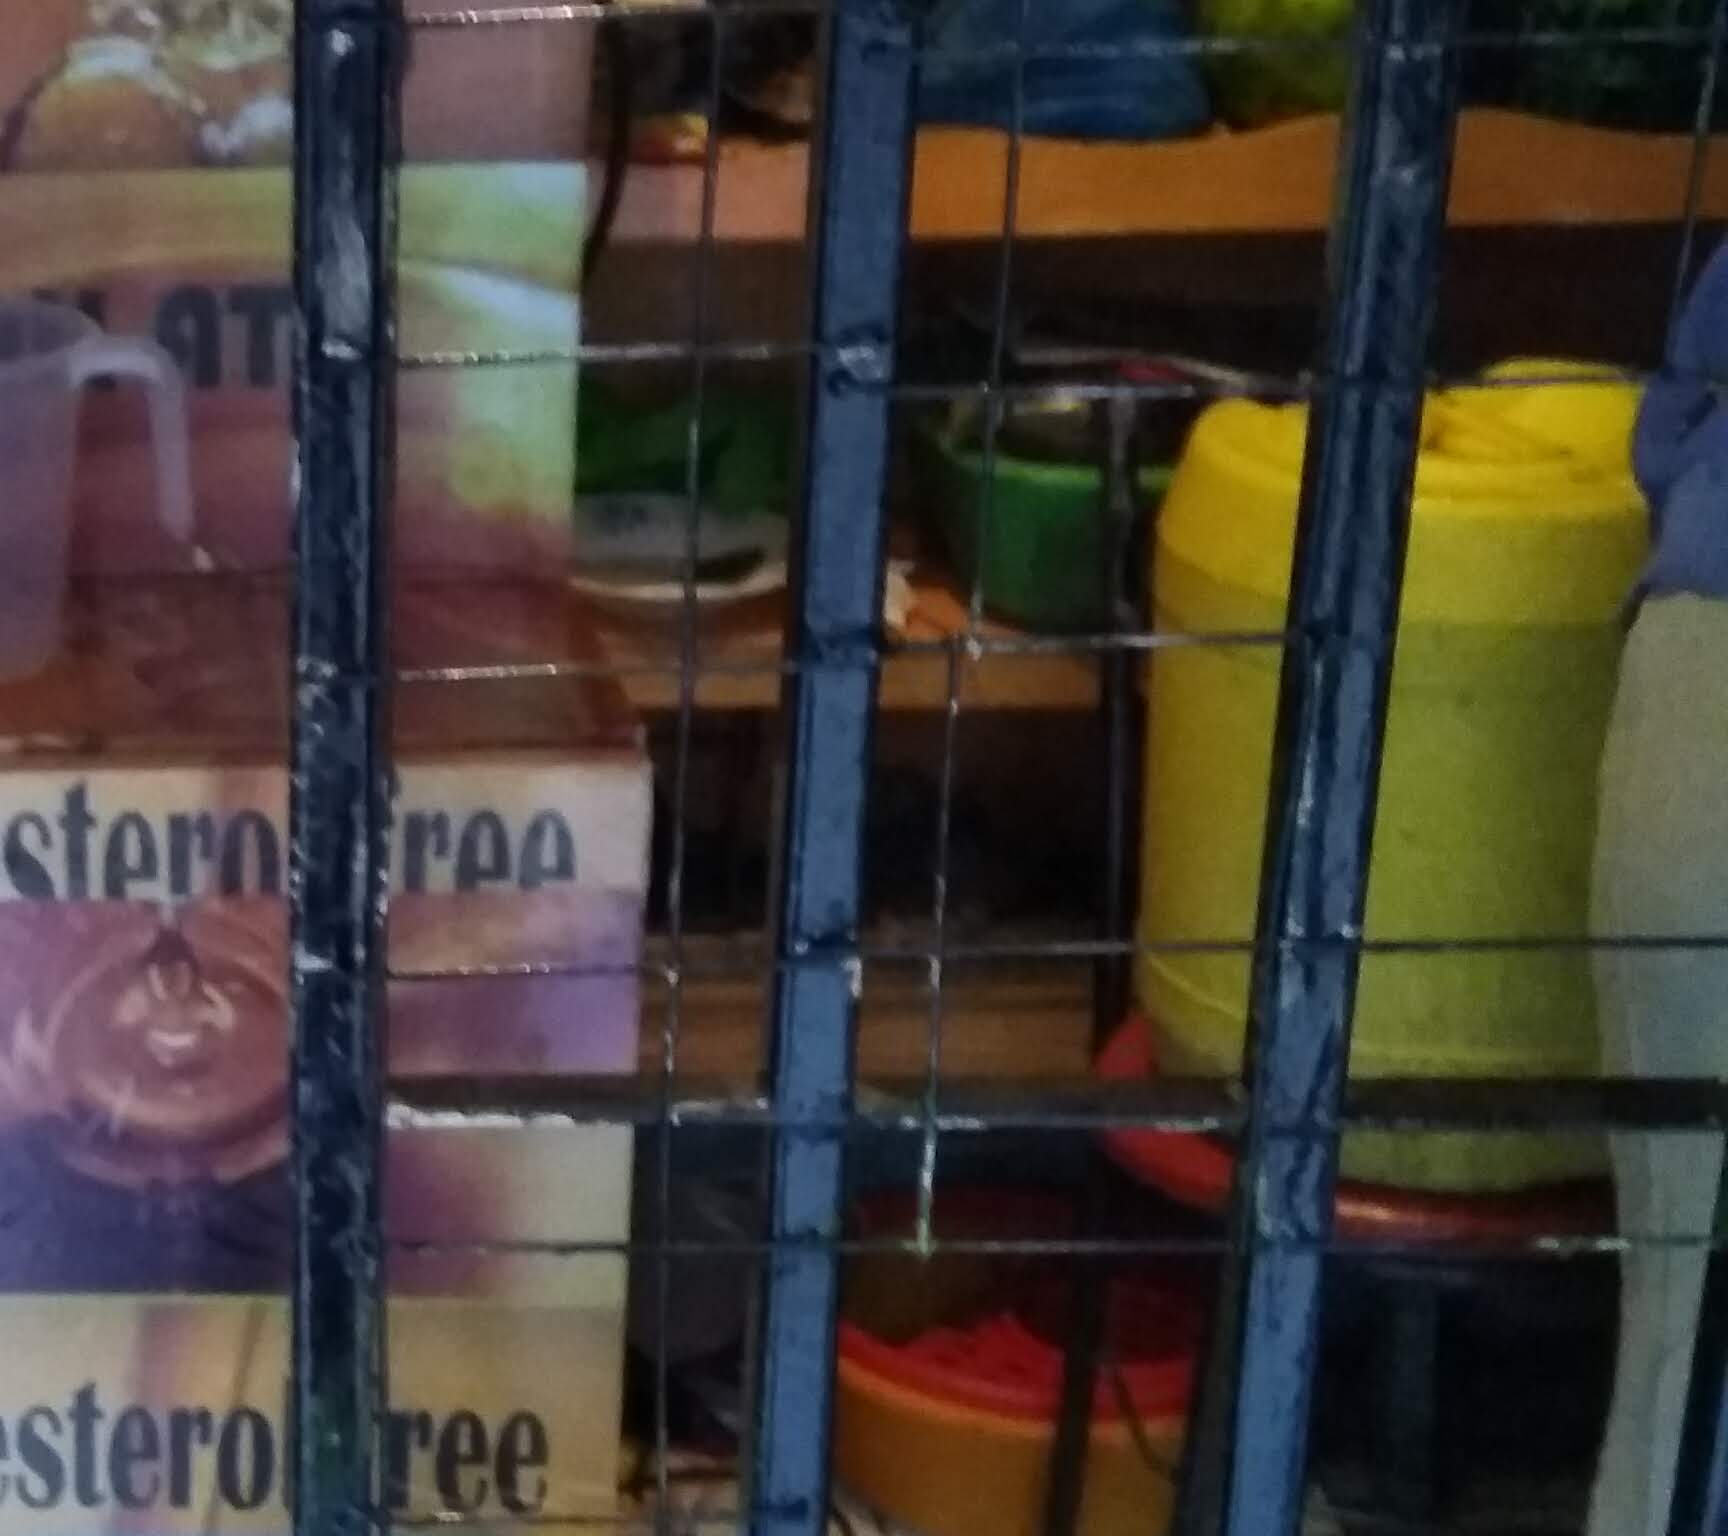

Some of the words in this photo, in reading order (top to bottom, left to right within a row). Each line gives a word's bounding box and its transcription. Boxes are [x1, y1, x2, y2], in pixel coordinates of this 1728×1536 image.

[154, 280, 298, 390] AT
[402, 807, 577, 893] ree
[378, 1407, 550, 1514] ree
